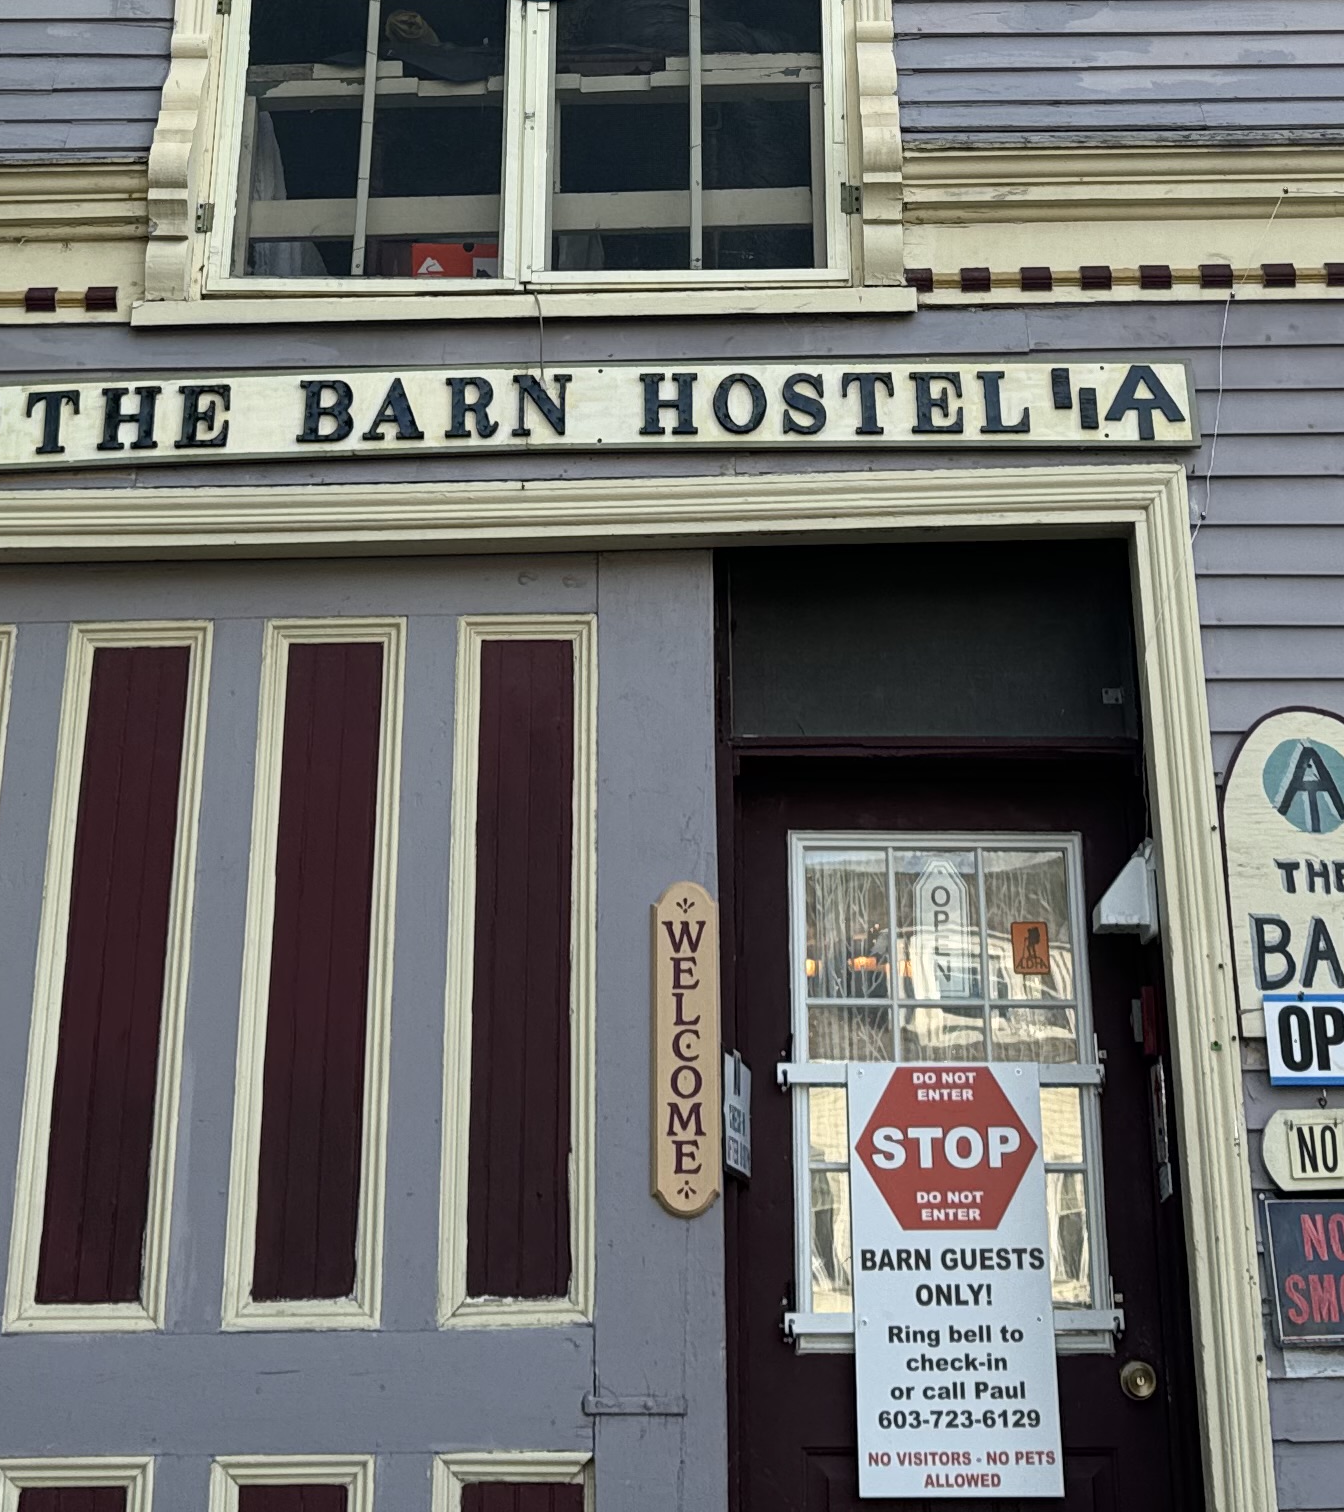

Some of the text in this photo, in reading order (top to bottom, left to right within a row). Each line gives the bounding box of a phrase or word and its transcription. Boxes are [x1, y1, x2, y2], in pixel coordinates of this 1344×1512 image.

[26, 384, 232, 454] THE
[296, 374, 573, 443] BARN
[639, 371, 1031, 434] HOSTEL
[930, 885, 952, 983] OPEN
[661, 920, 707, 1175] WELCOME
[912, 1071, 976, 1084] DO NOT
[917, 1089, 974, 1101] ENTER
[871, 1126, 1021, 1169] STOP
[1297, 1126, 1339, 1174] NO
[916, 1191, 984, 1204] DO NOT
[921, 1208, 981, 1221] ENTER
[861, 1248, 1045, 1271] BARN GUESTS
[915, 1283, 992, 1307] ONLY!
[887, 1325, 1024, 1348] Ring bell to
[906, 1352, 1008, 1372] check-in
[890, 1381, 1026, 1400] or call Paul
[878, 1409, 1041, 1429] 603-723-6129
[868, 1450, 1056, 1467] NO VISITORS NO PETS
[924, 1473, 1001, 1488] ALLOWED
